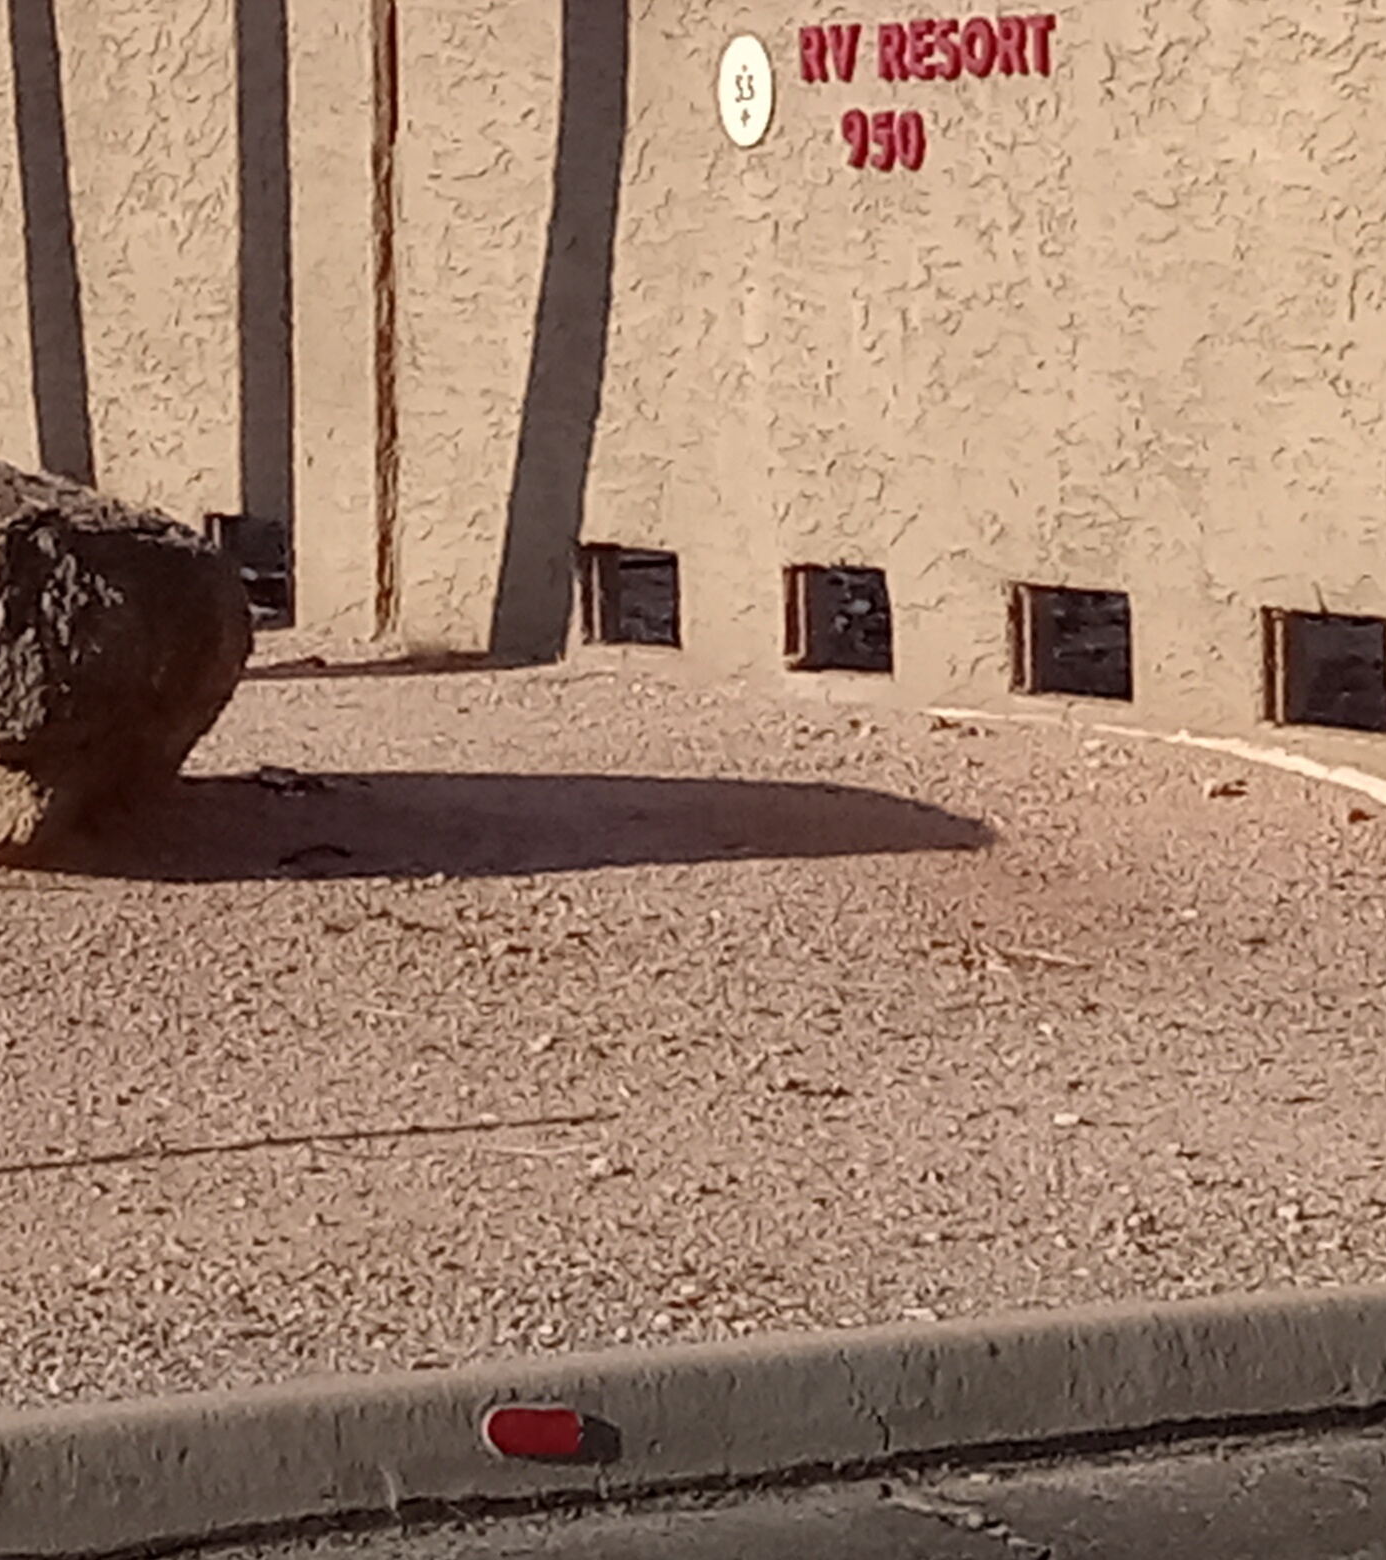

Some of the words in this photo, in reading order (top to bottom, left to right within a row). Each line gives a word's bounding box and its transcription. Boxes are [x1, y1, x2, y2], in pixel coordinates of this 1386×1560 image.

[798, 23, 862, 83] RV
[877, 13, 1057, 82] RESORT
[840, 108, 927, 172] 950
